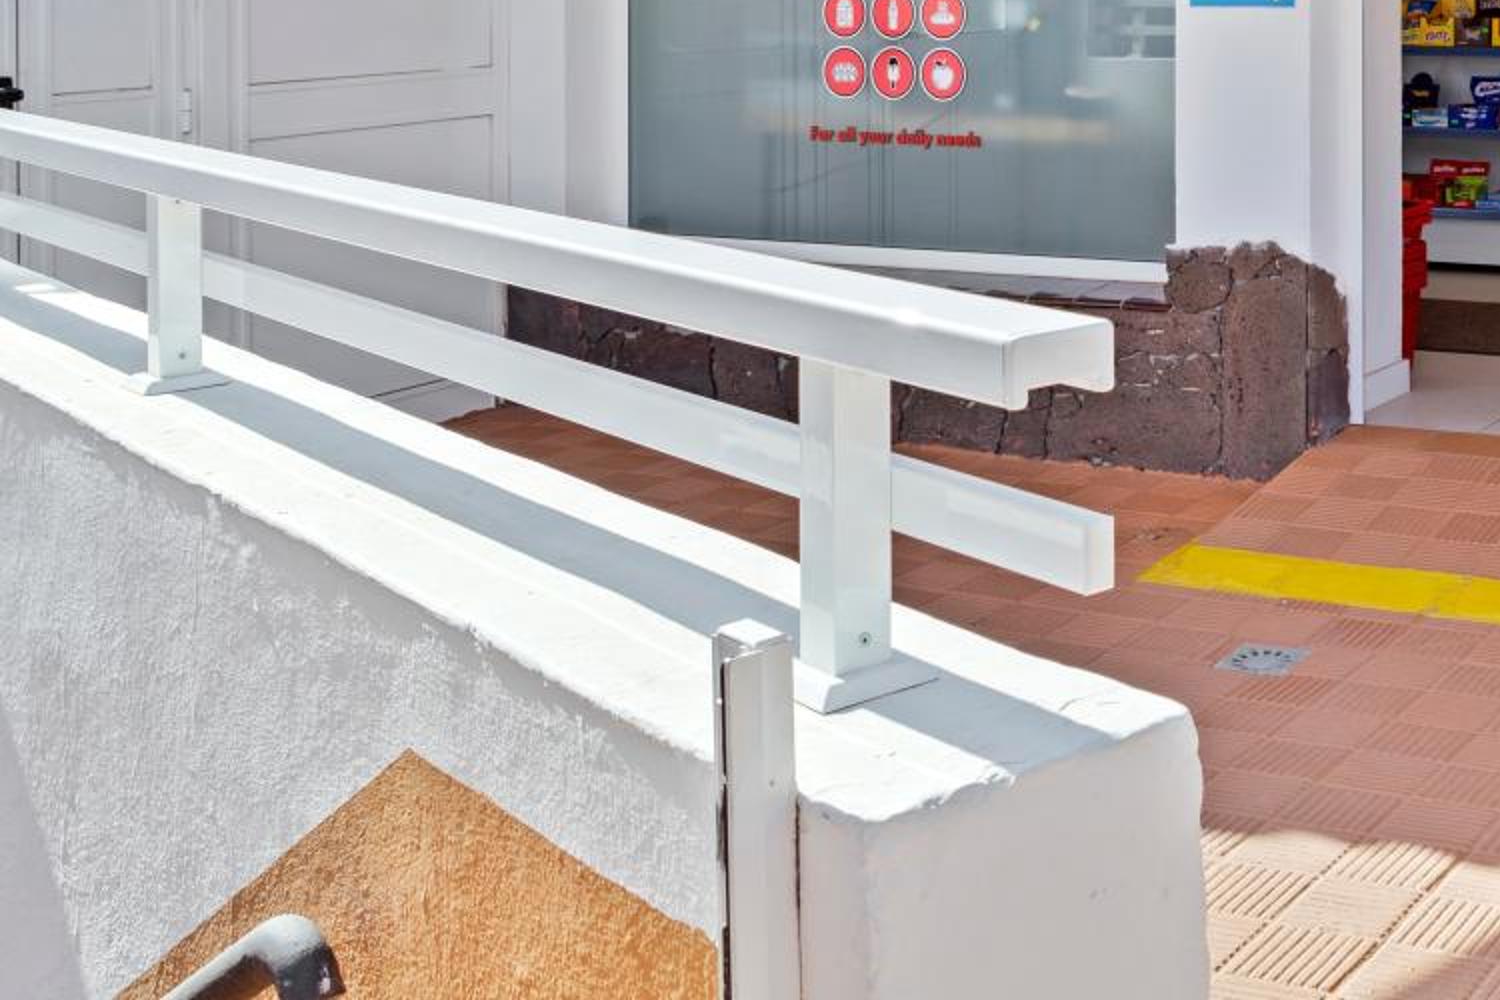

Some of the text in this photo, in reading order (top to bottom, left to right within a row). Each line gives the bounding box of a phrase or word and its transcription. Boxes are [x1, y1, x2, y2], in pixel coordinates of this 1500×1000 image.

[808, 125, 983, 149] For all your daily needs
